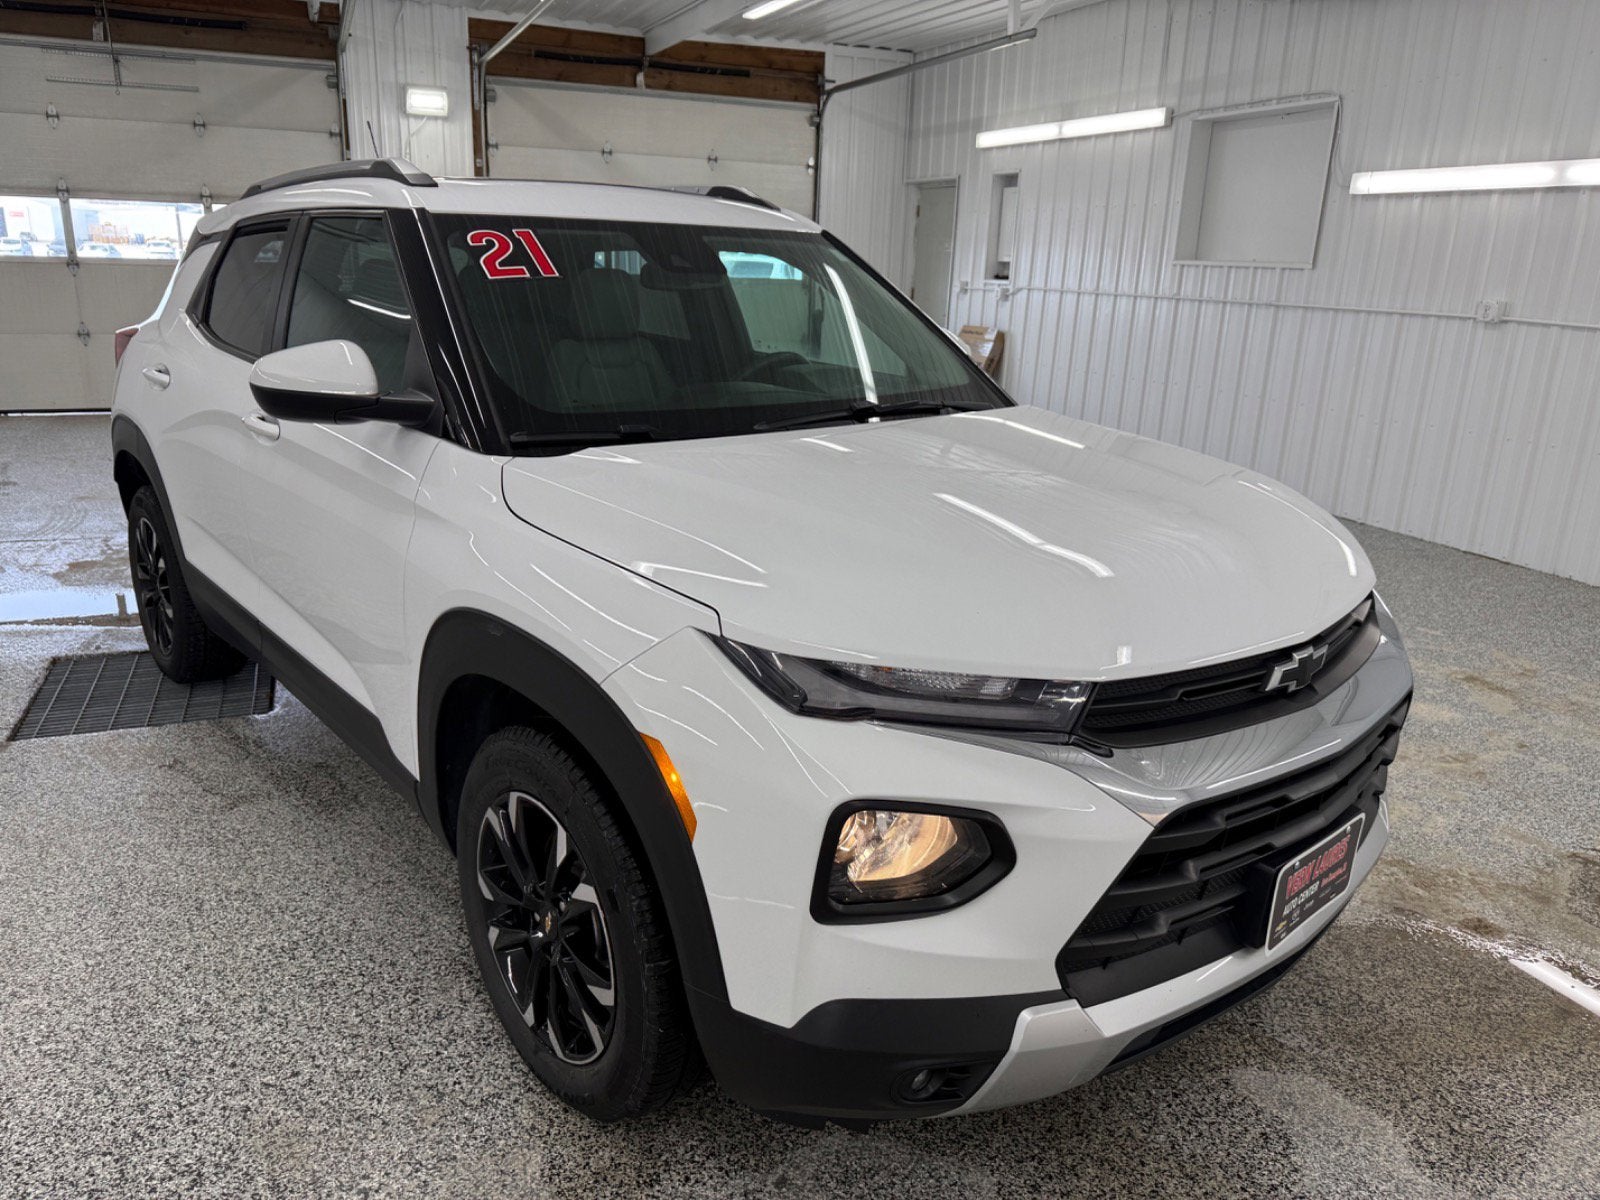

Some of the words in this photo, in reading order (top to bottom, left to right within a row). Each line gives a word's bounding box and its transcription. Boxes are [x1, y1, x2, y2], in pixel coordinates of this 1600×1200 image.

[467, 229, 560, 279] 21
[1283, 897, 1298, 916] AUTO
[1298, 881, 1320, 905] CENTER
